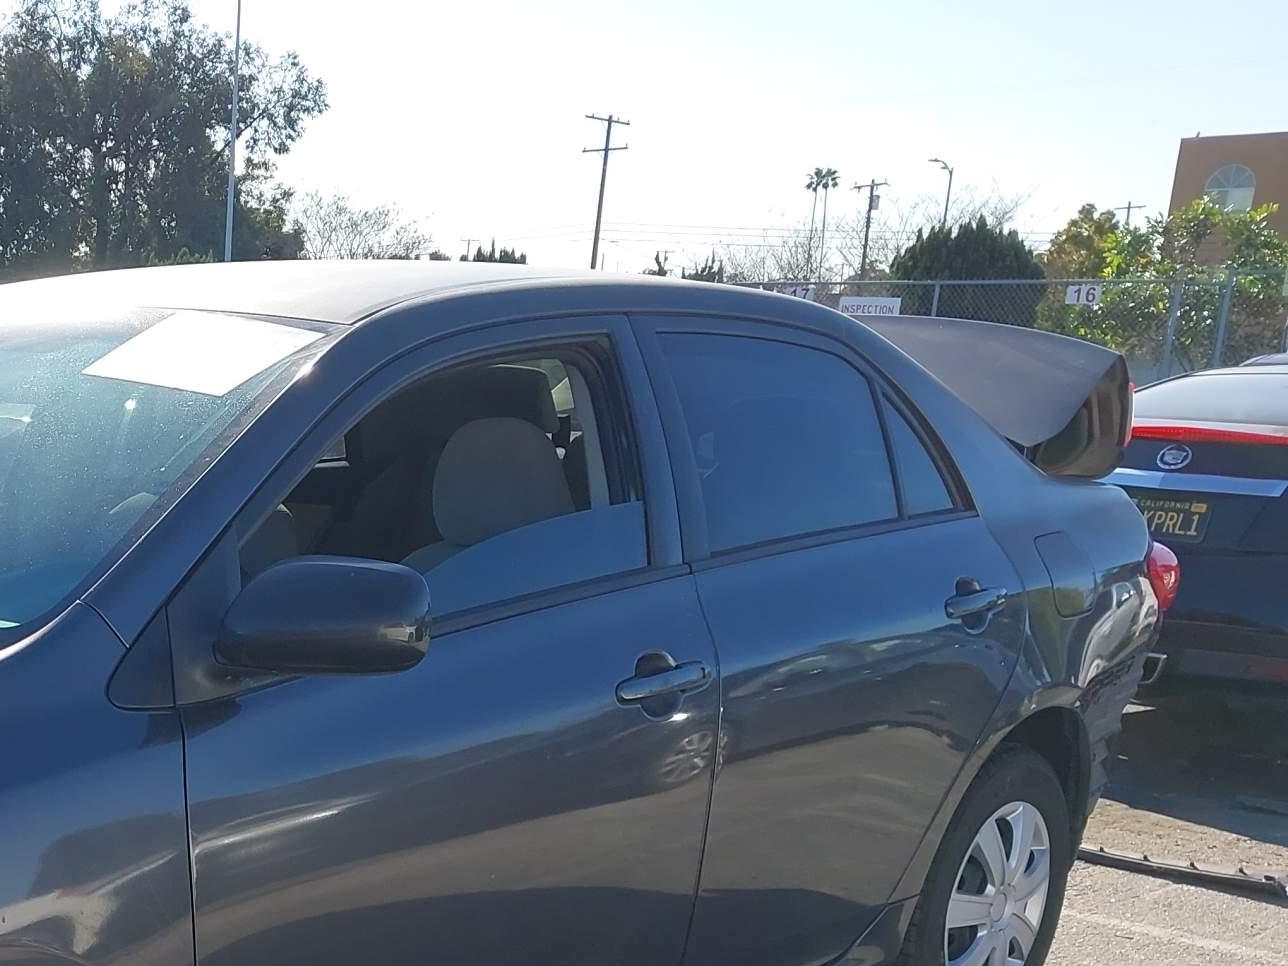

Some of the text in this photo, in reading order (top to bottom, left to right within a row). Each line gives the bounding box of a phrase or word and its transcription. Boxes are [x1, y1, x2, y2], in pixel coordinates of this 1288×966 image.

[1074, 286, 1097, 303] 16
[840, 304, 895, 314] INSPECTION
[1140, 499, 1190, 510] CALIFORNIA
